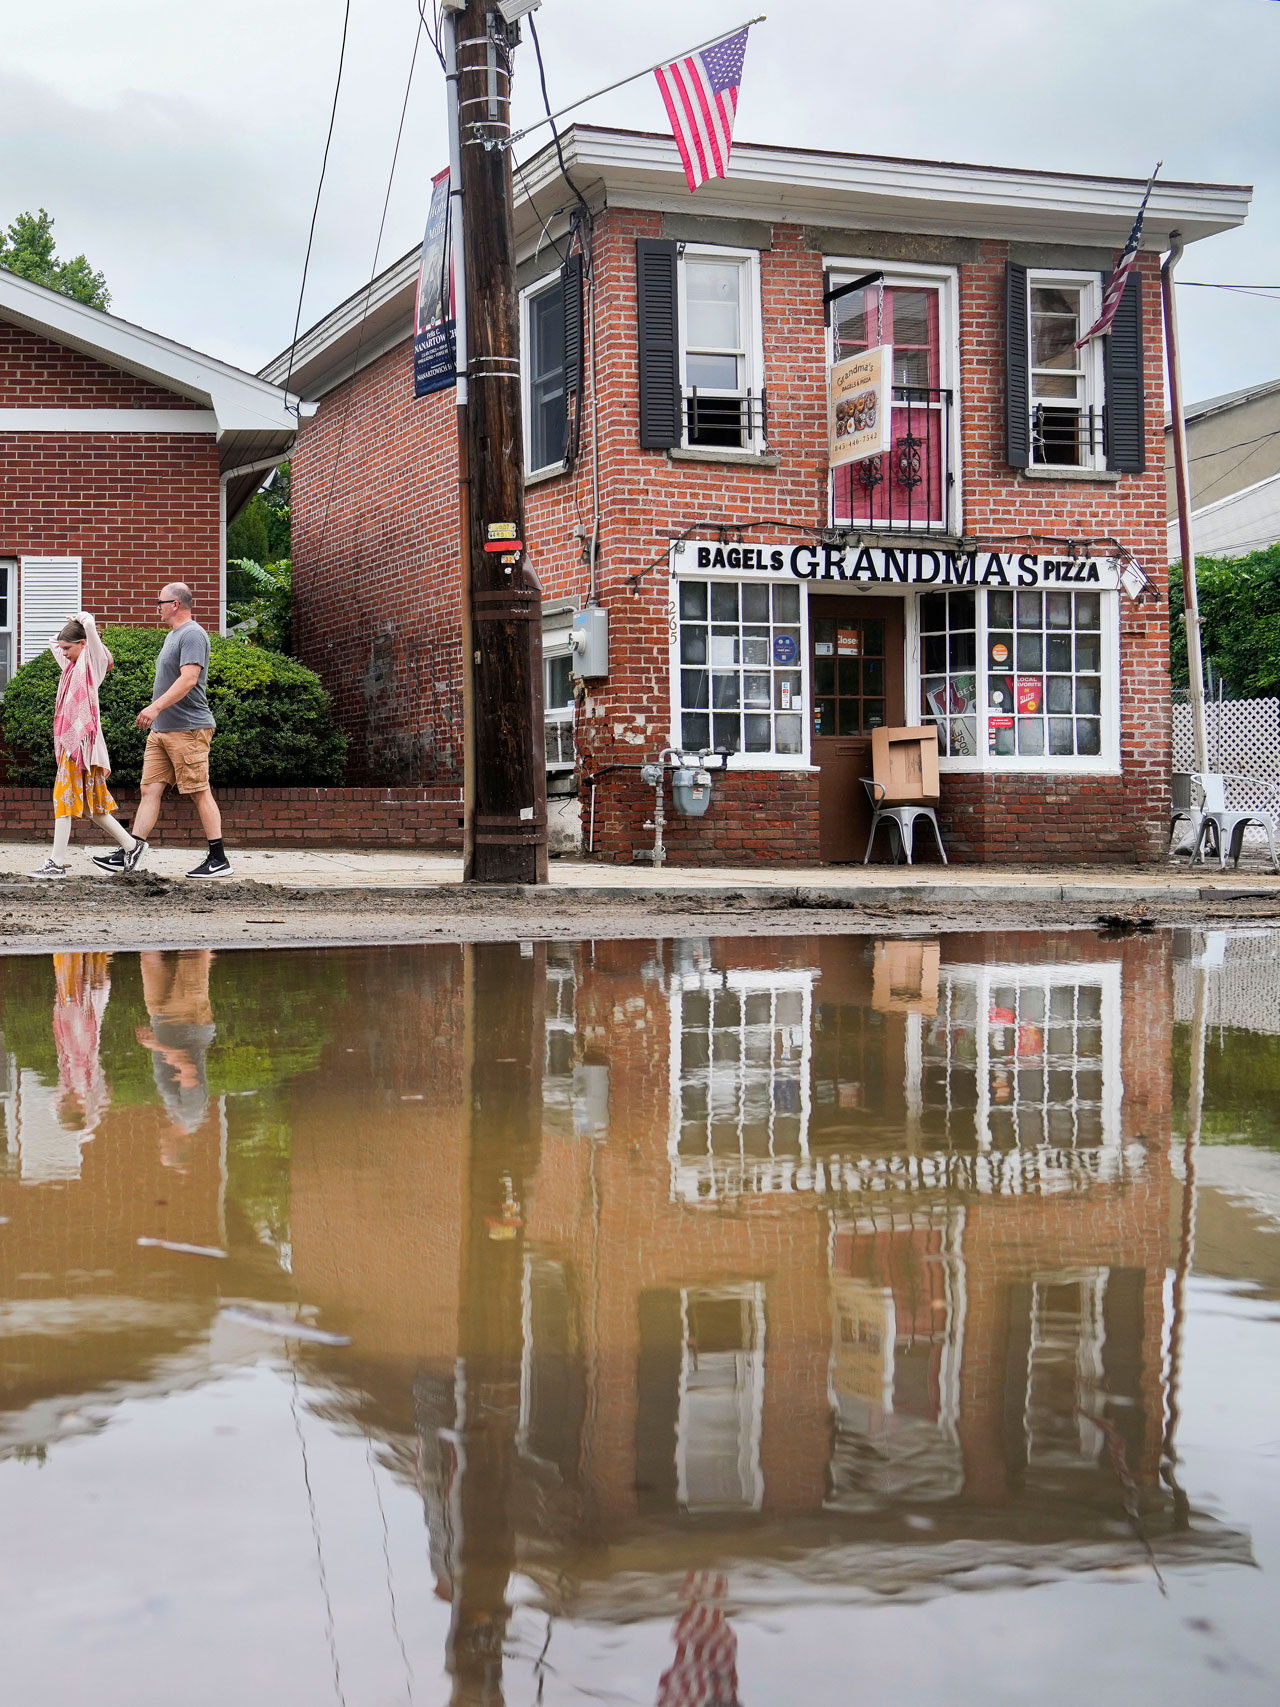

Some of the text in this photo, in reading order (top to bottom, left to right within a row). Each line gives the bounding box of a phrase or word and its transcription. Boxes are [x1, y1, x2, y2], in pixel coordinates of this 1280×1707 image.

[414, 328, 456, 353] NANARTOWH
[837, 363, 874, 387] Grandma's
[698, 545, 1100, 587] BAGELS GRANDMA'S PIZZA
[669, 600, 678, 644] 265
[838, 635, 858, 645] lose
[957, 684, 975, 698] BEC
